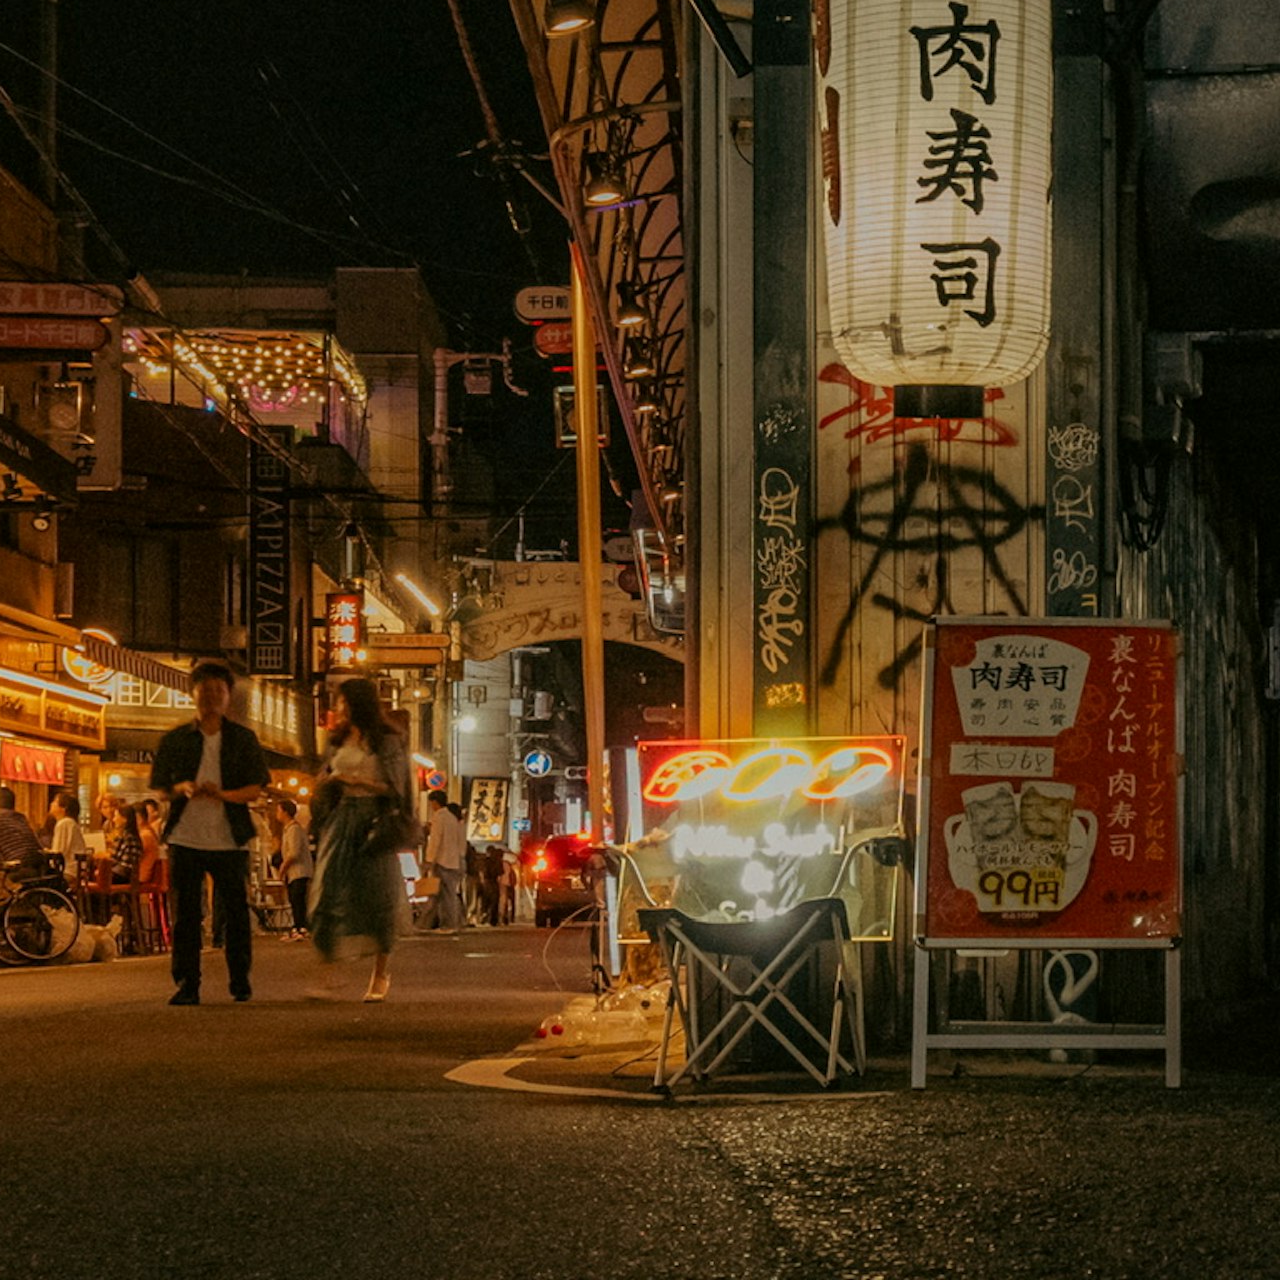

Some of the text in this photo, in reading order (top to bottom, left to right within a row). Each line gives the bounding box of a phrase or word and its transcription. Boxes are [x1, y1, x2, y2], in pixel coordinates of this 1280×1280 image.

[910, 0, 1001, 326] 肉寿司
[970, 662, 1069, 691] 肉寿司
[992, 643, 1048, 659] 裏なんば
[1107, 634, 1141, 754] 裏なんば
[1144, 634, 1167, 861] リニューアルオープン記念
[1107, 769, 1138, 862] 肉寿司
[979, 871, 1060, 906] 99円
